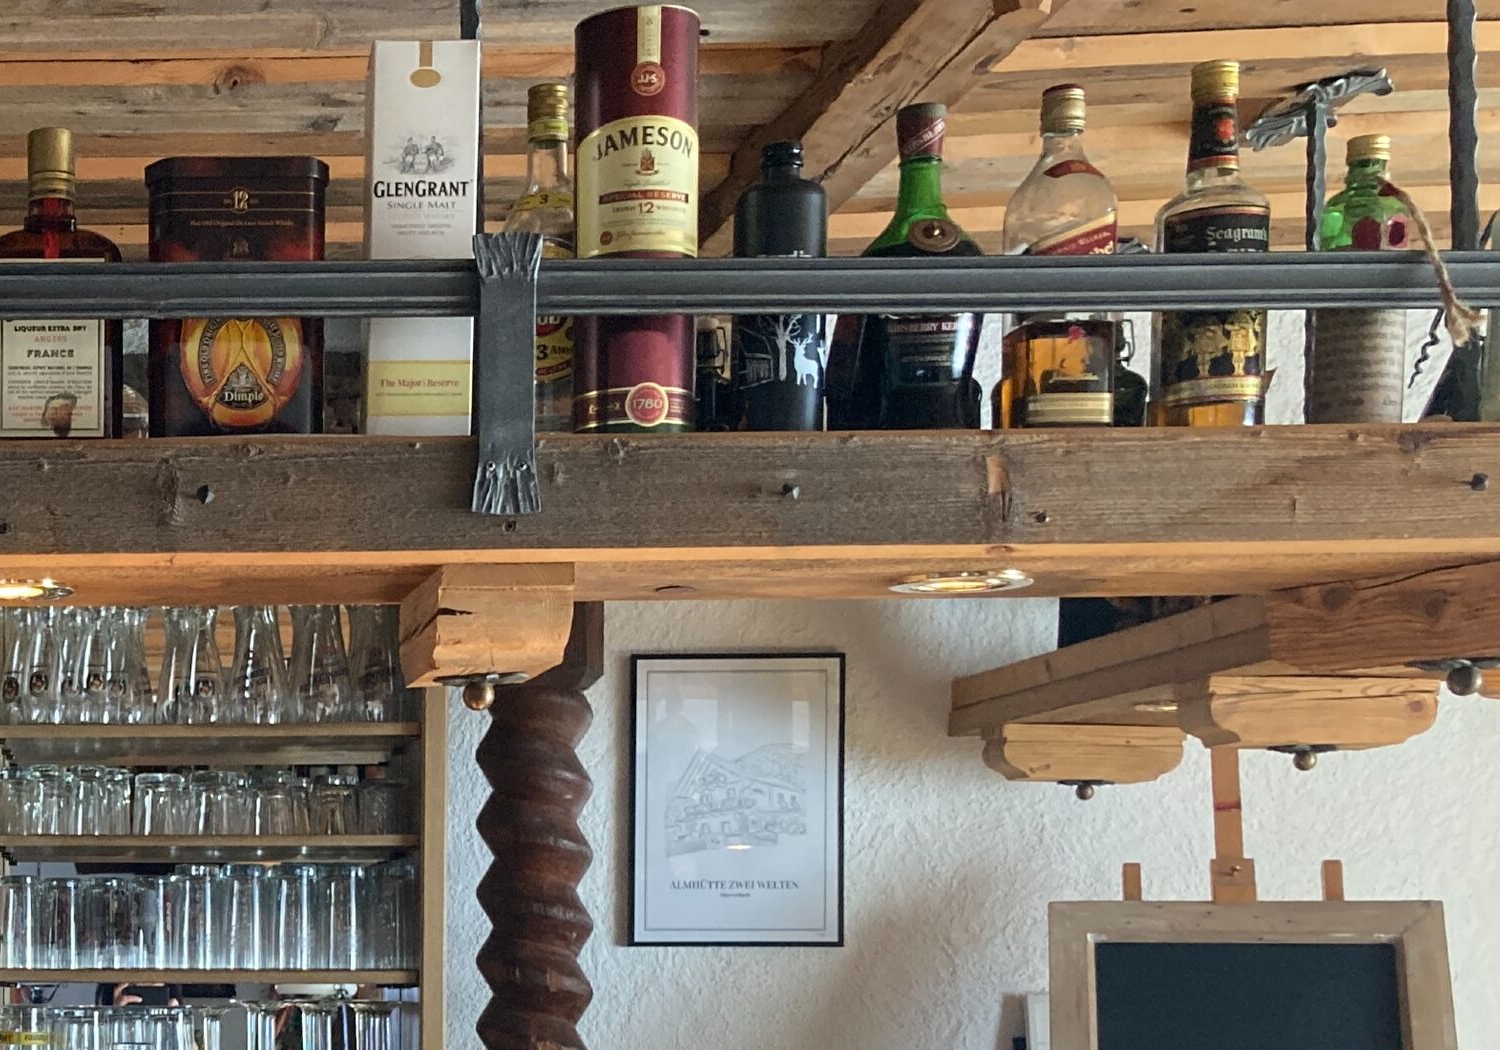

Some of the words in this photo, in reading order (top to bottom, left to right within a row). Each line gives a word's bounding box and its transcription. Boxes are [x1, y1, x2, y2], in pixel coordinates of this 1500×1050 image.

[595, 126, 693, 161] JAMESON
[234, 190, 249, 209] 12
[602, 192, 643, 203] SPECIAL
[646, 190, 686, 201] RESERVE
[387, 201, 422, 209] SINGLE
[428, 201, 456, 209] MALT
[638, 202, 654, 214] 12
[27, 349, 75, 358] FRANCE
[381, 379, 396, 387] The
[427, 379, 460, 387] Reserve
[224, 391, 265, 404] Dimple
[633, 399, 663, 410] 1780
[670, 878, 726, 889] ALMHÜTTE
[728, 879, 755, 889] ZWEI
[756, 879, 799, 889] WELTEN
